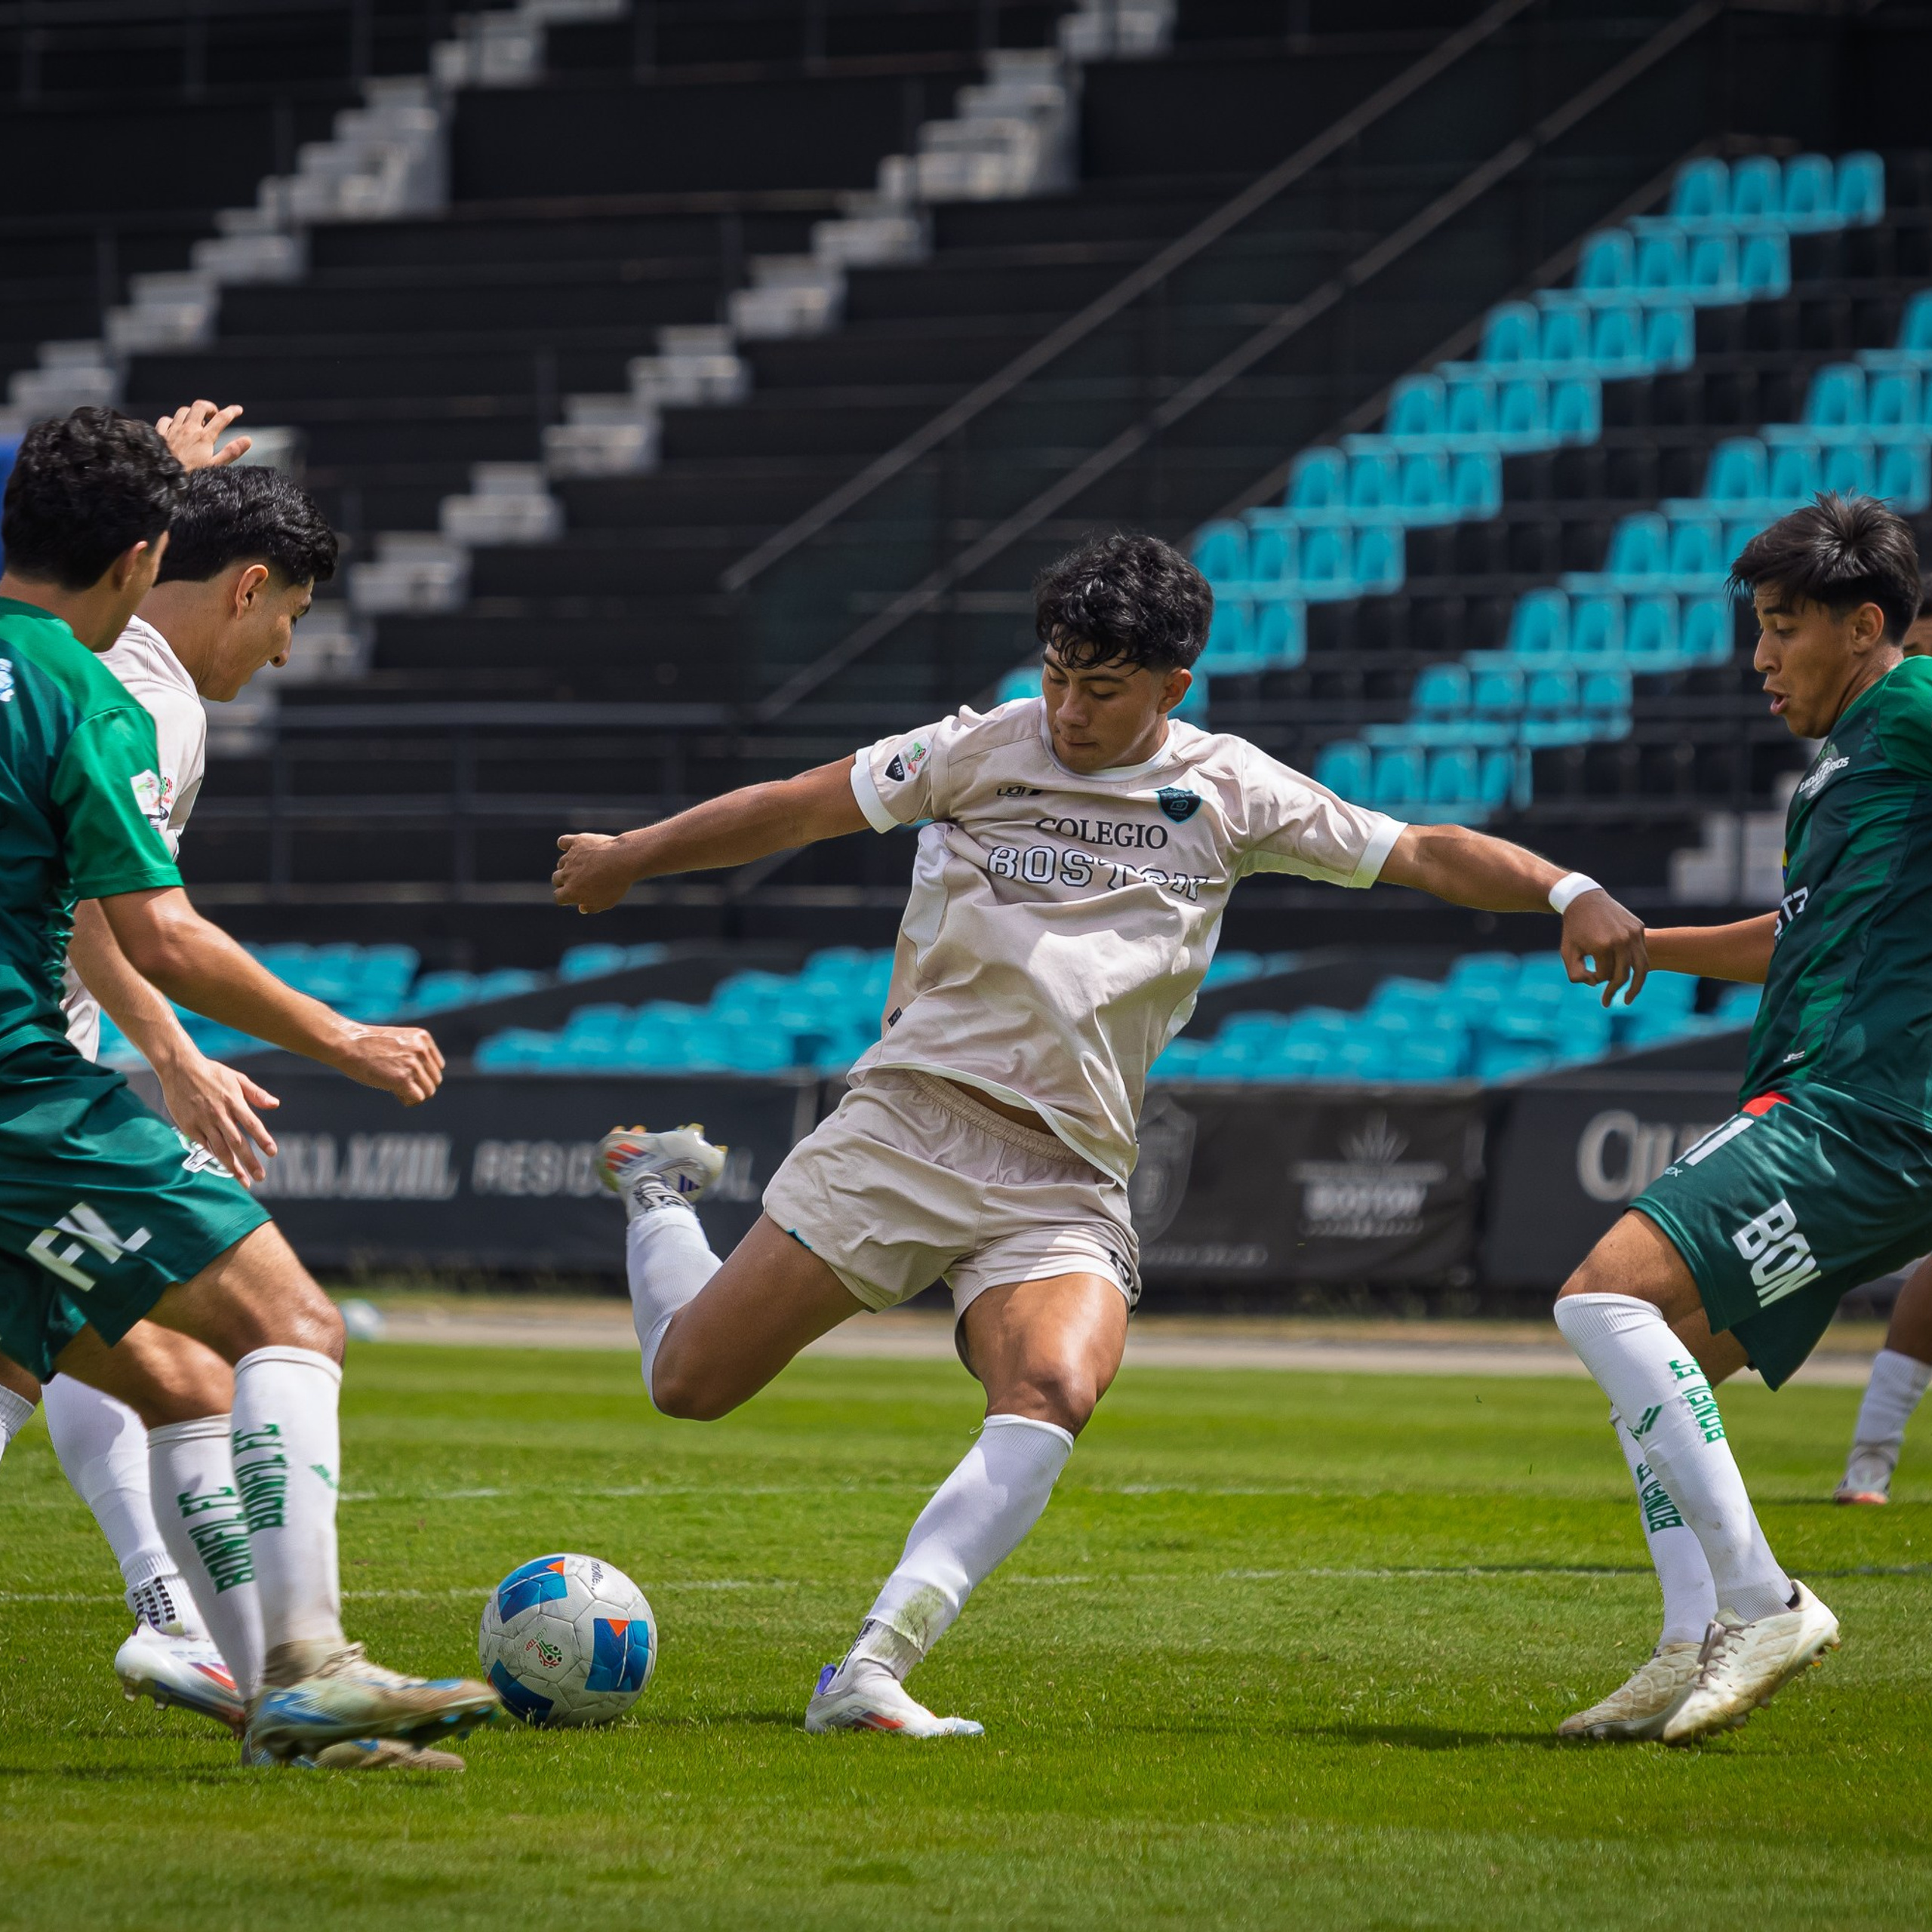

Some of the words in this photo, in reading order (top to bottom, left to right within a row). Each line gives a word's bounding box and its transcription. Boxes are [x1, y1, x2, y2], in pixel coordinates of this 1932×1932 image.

[894, 761, 904, 777] FMF
[1731, 1198, 1822, 1309] BON
[1669, 1358, 1706, 1380] FC
[1681, 1380, 1727, 1444] BONFIL
[232, 1423, 284, 1457] FC
[177, 1486, 241, 1519] FC
[233, 1454, 290, 1534] BONFIL
[187, 1512, 255, 1595] BONFIL
